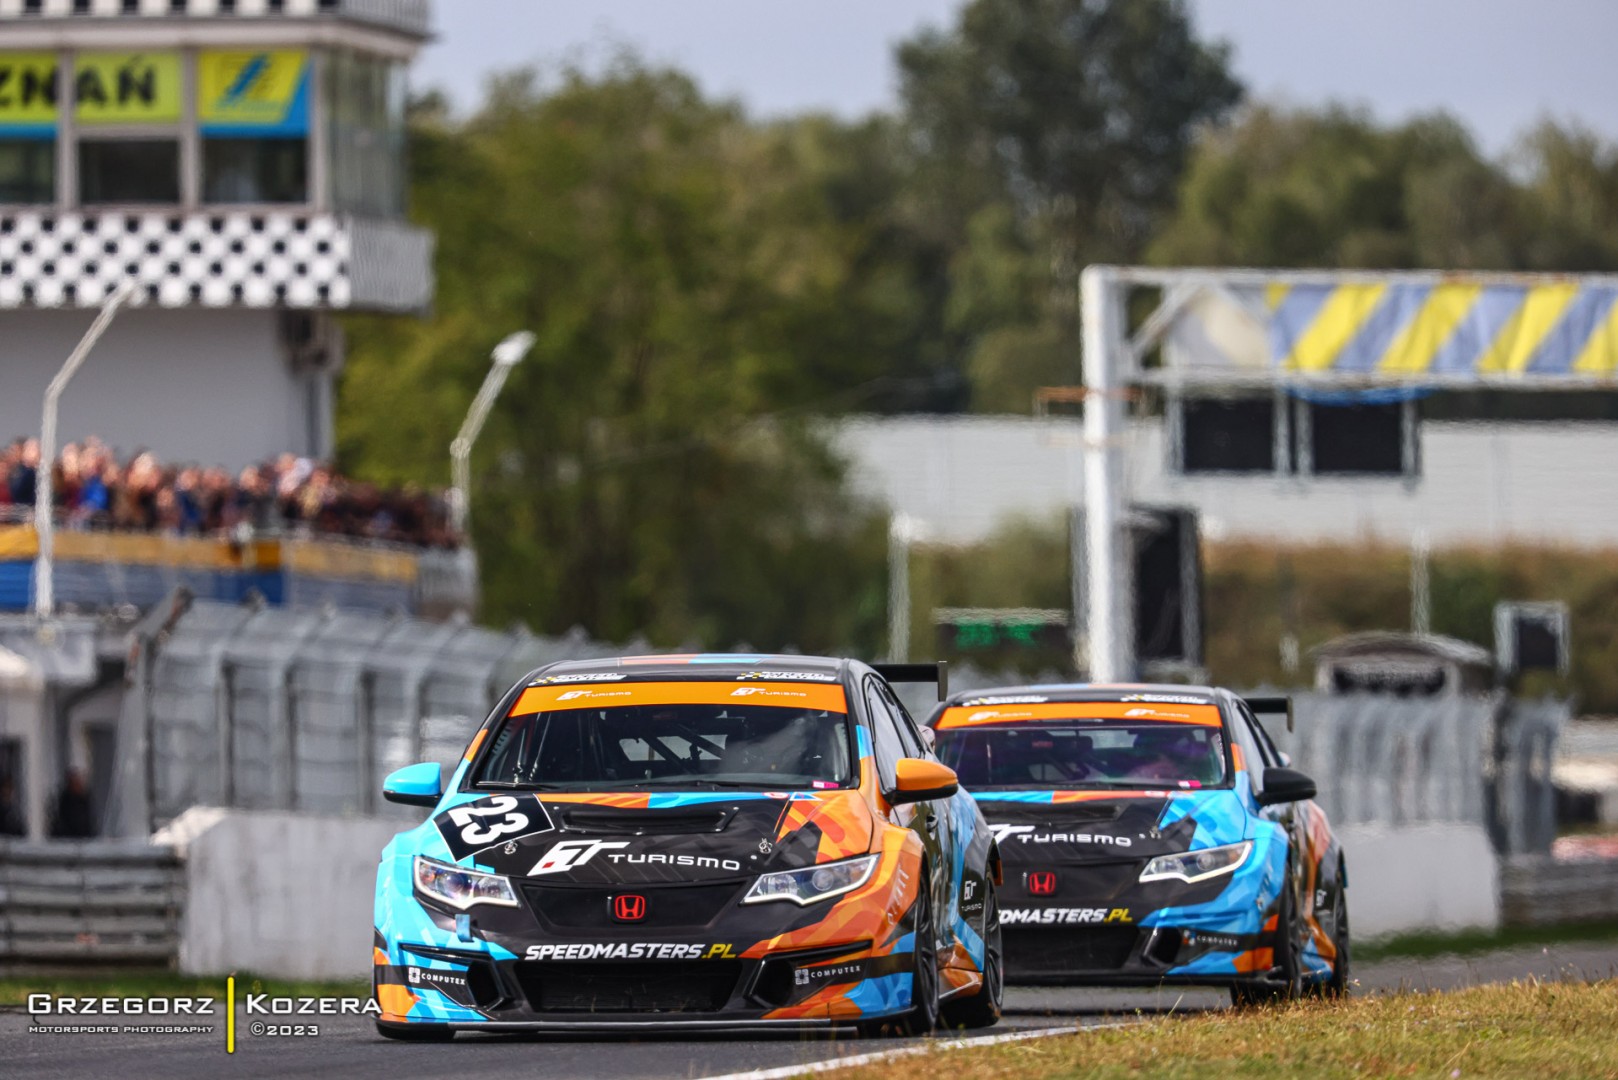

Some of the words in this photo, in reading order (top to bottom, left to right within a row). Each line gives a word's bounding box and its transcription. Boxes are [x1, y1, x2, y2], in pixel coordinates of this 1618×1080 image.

[447, 796, 529, 845] 23
[1017, 833, 1132, 847] TURISMO
[608, 854, 740, 871] TURISMO
[998, 908, 1132, 924] DMASTERS.PL
[524, 943, 736, 961] SPEEDMASTERS.PL
[421, 973, 466, 985] COMPUTEX
[811, 965, 861, 978] COMPUTEX
